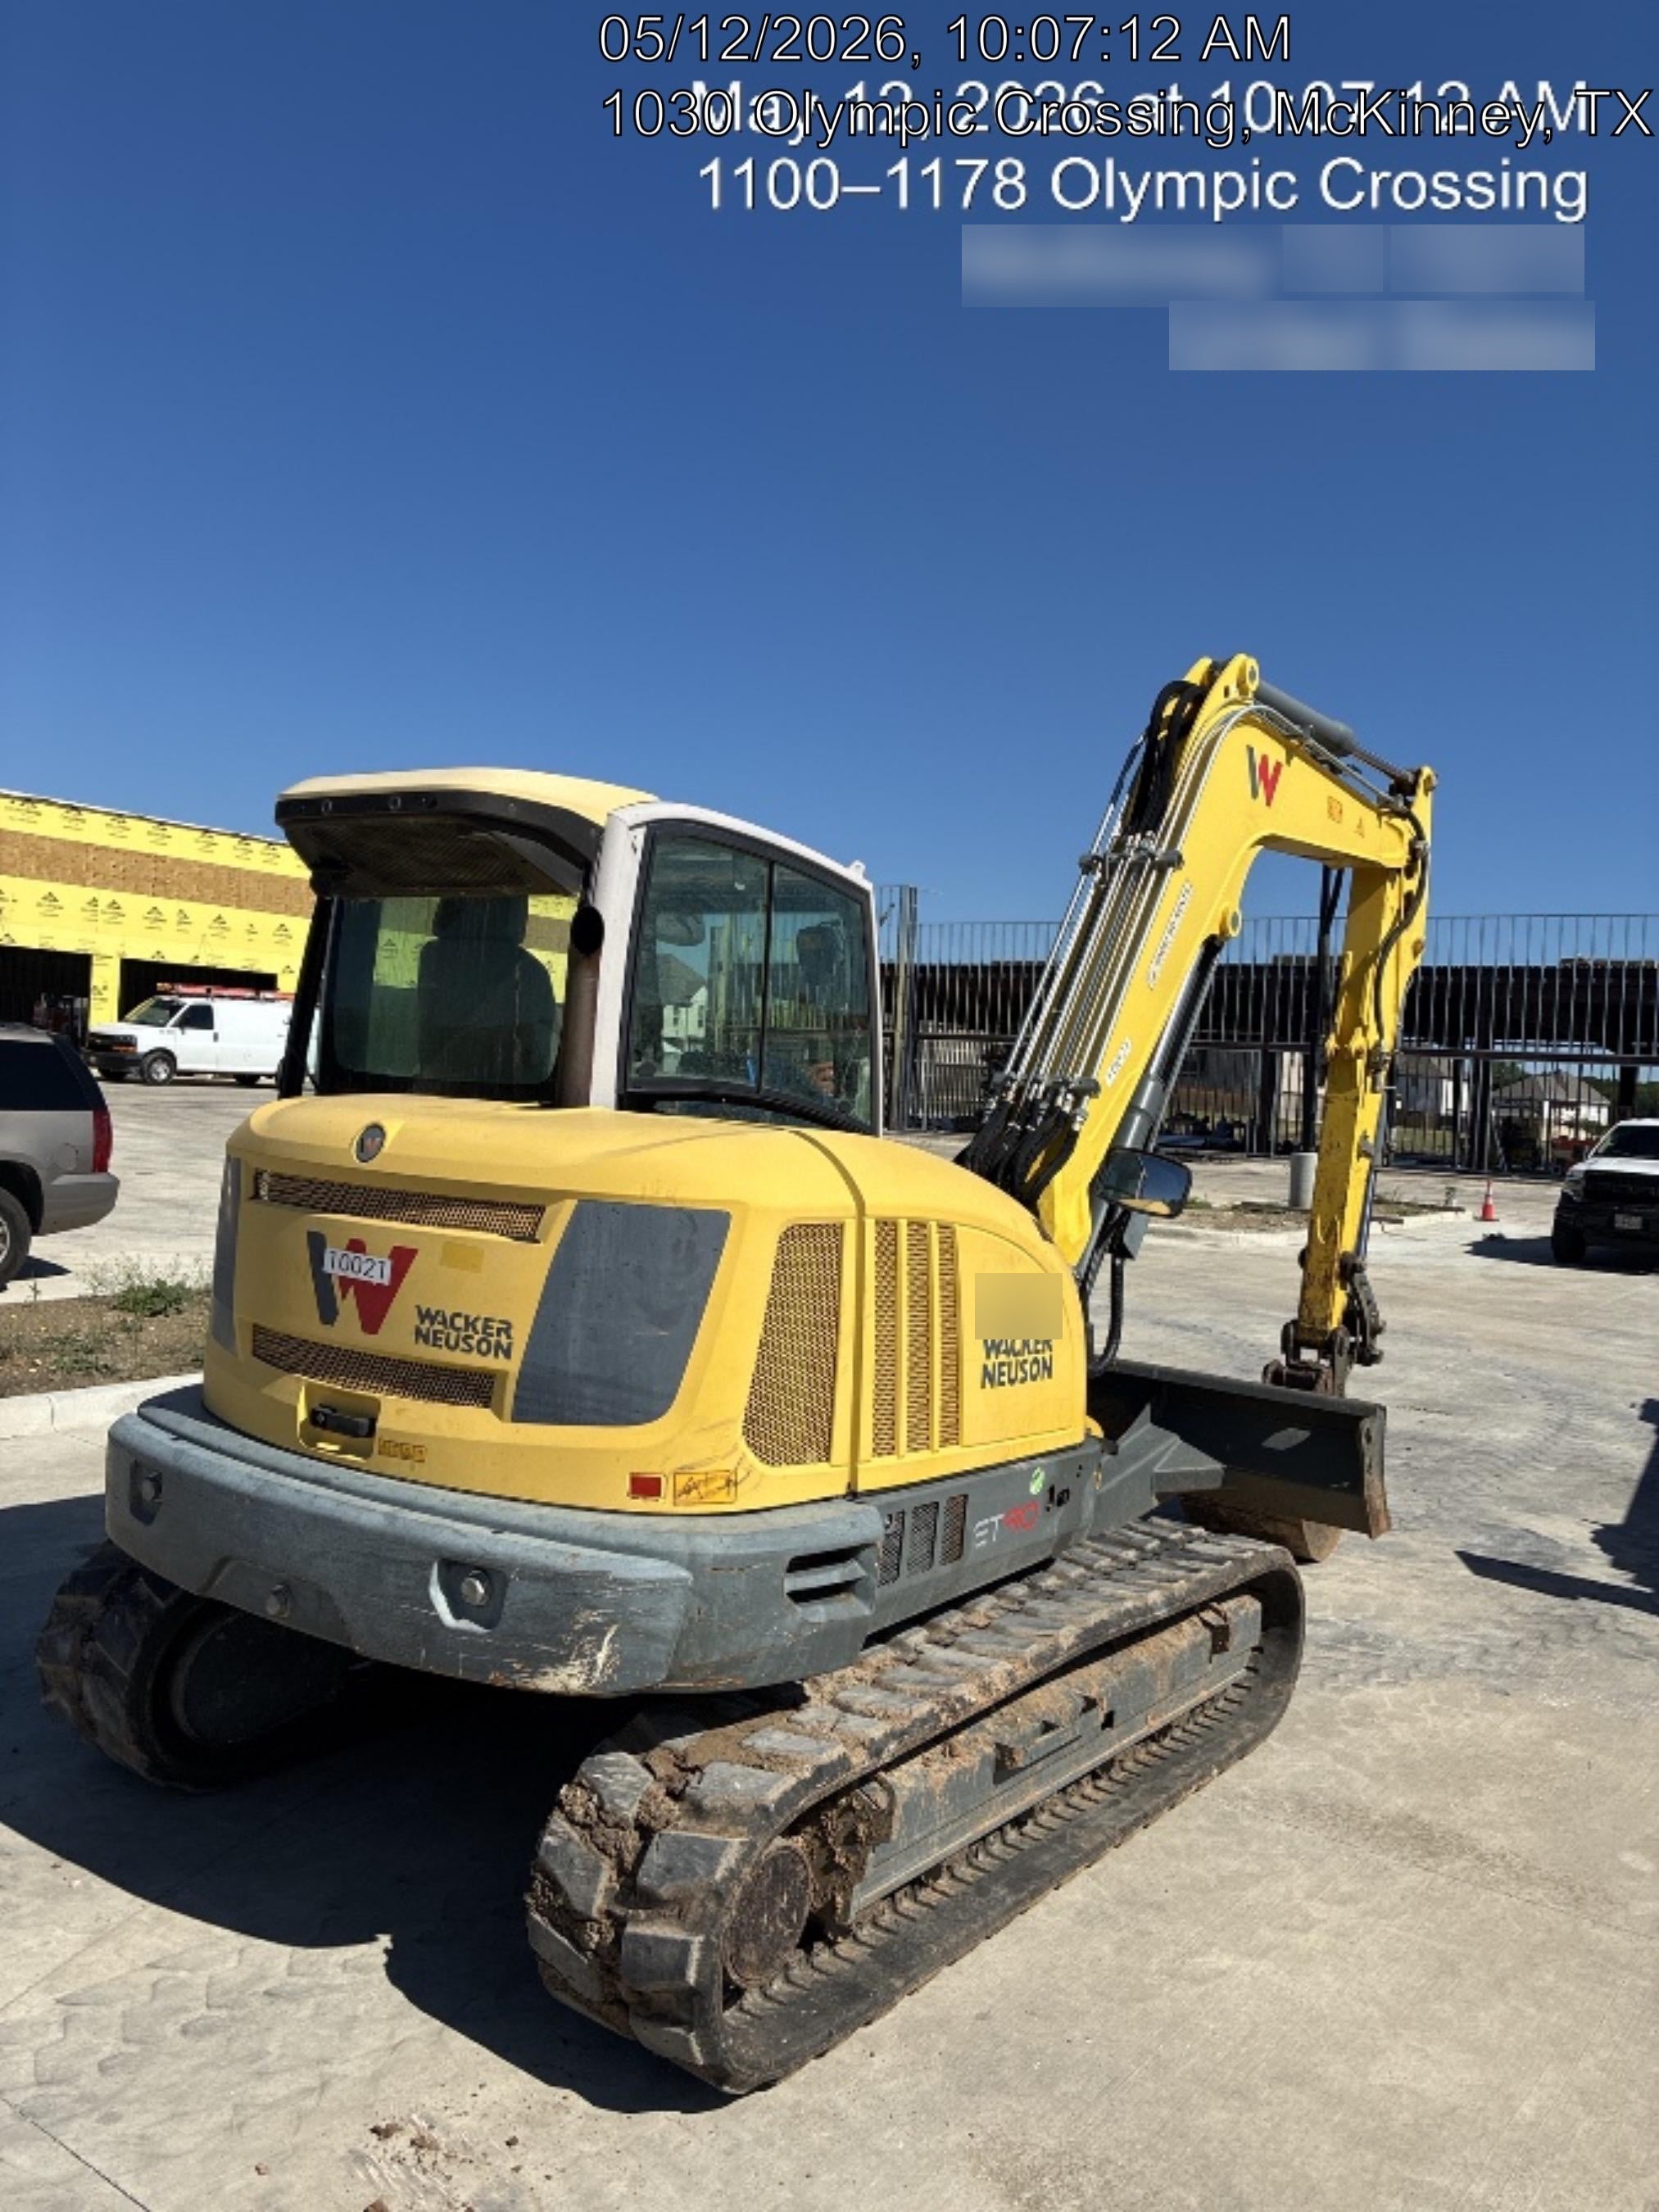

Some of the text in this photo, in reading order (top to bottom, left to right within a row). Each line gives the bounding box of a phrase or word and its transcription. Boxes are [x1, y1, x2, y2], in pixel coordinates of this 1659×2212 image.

[328, 1250, 386, 1281] 10021
[415, 1304, 512, 1339] WACKER
[415, 1326, 512, 1360] NEUSON
[981, 1354, 1053, 1389] NEUSON
